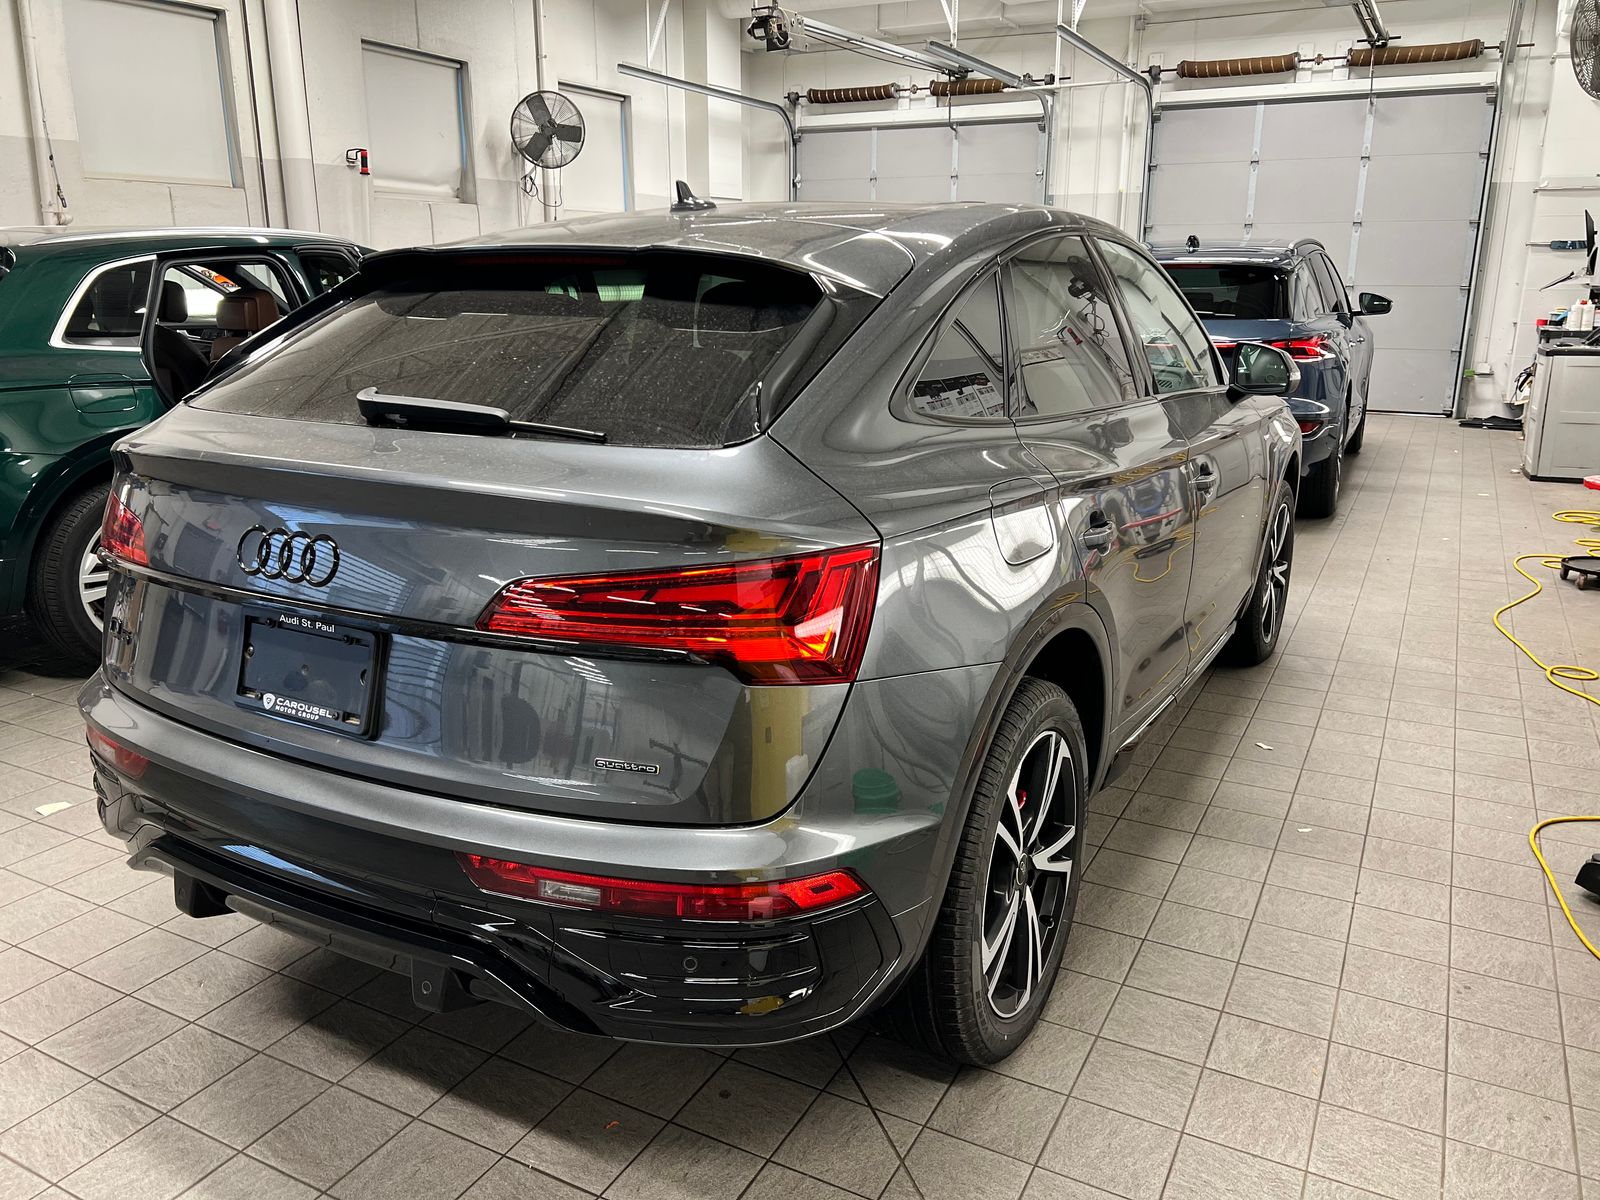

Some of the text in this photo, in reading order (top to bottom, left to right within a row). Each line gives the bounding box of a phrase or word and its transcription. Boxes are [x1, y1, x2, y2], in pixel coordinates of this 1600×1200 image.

[279, 614, 335, 633] Audi St. Paul
[275, 704, 320, 721] MOTOR GROUP
[276, 697, 333, 718] CAROUSEL
[596, 760, 656, 772] quattro
